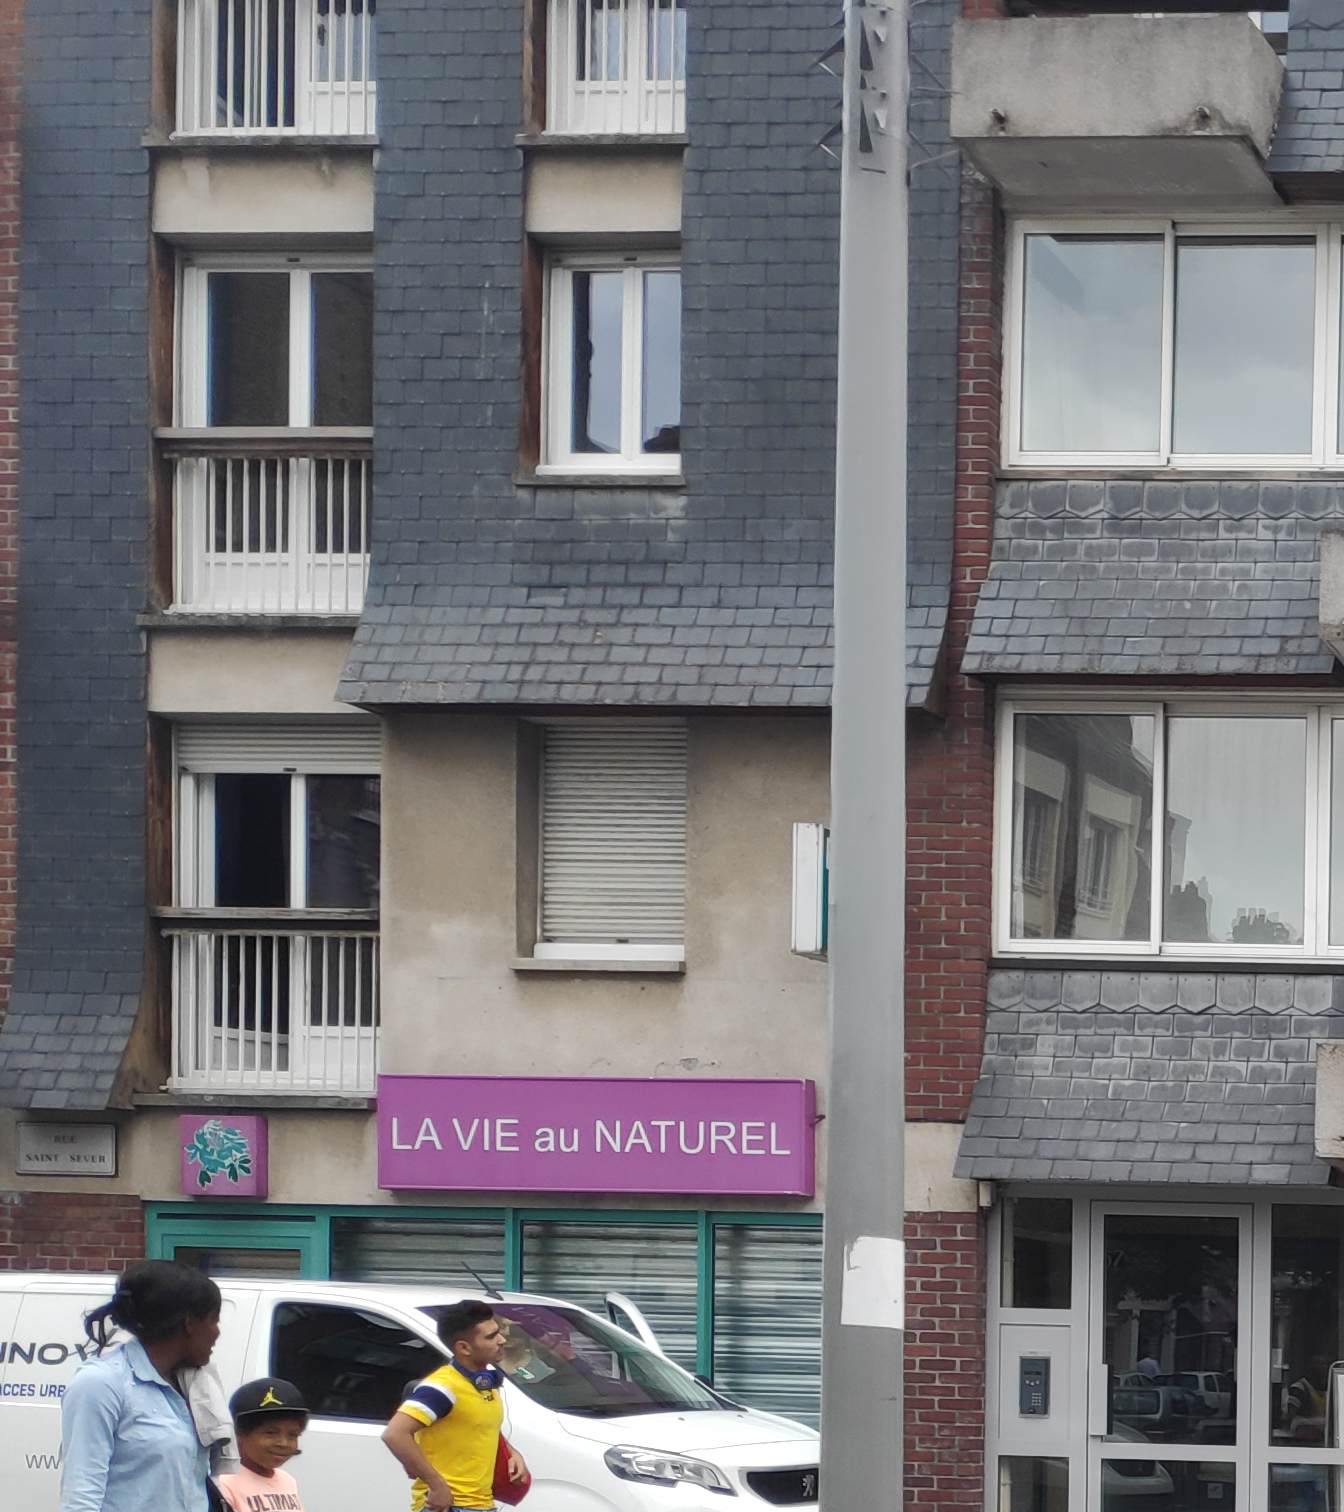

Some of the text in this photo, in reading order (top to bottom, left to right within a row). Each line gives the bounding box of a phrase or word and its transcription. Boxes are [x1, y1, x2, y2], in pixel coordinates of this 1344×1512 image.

[54, 1135, 78, 1144] RUE
[390, 1117, 792, 1156] LA VIE au NATUREL
[25, 1153, 106, 1163] SAINT SEVER
[0, 1383, 67, 1397] CCES URB
